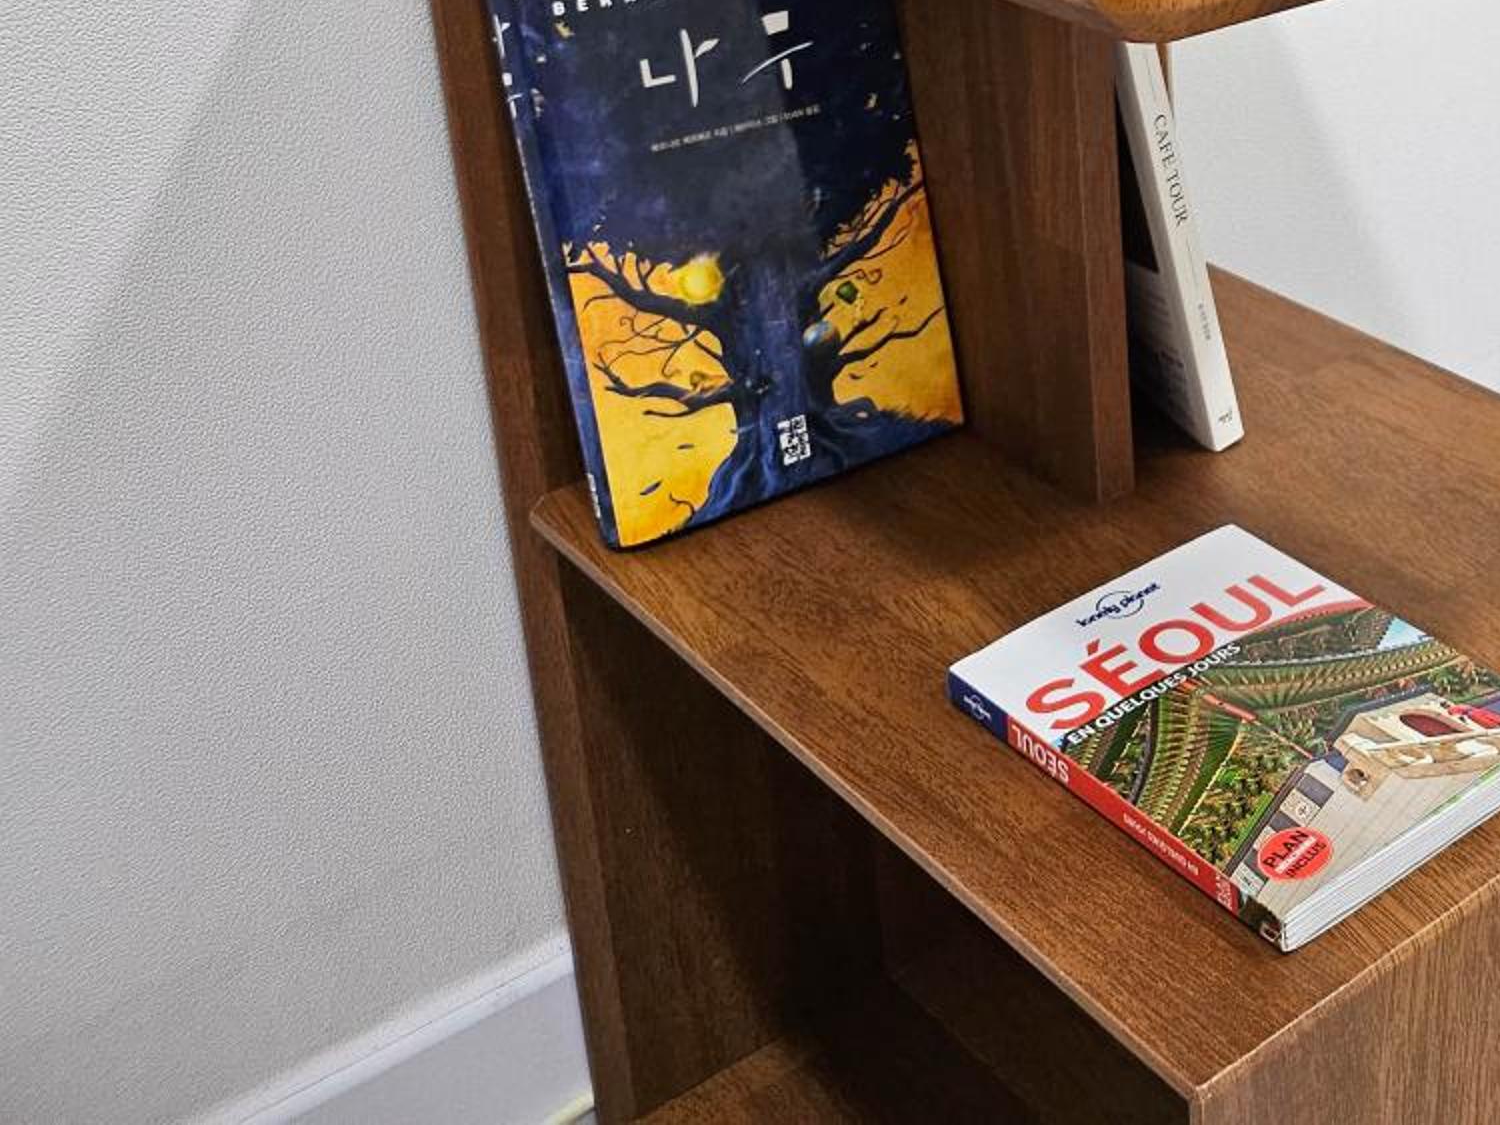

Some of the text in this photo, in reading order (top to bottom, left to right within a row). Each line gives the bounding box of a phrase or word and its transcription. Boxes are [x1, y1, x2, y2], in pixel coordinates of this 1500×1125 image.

[1166, 169, 1189, 227] TOUR
[1025, 574, 1326, 730] SÉOUL
[1067, 641, 1243, 747] EN QUELQUES JOURS
[1262, 830, 1309, 868] PLAN
